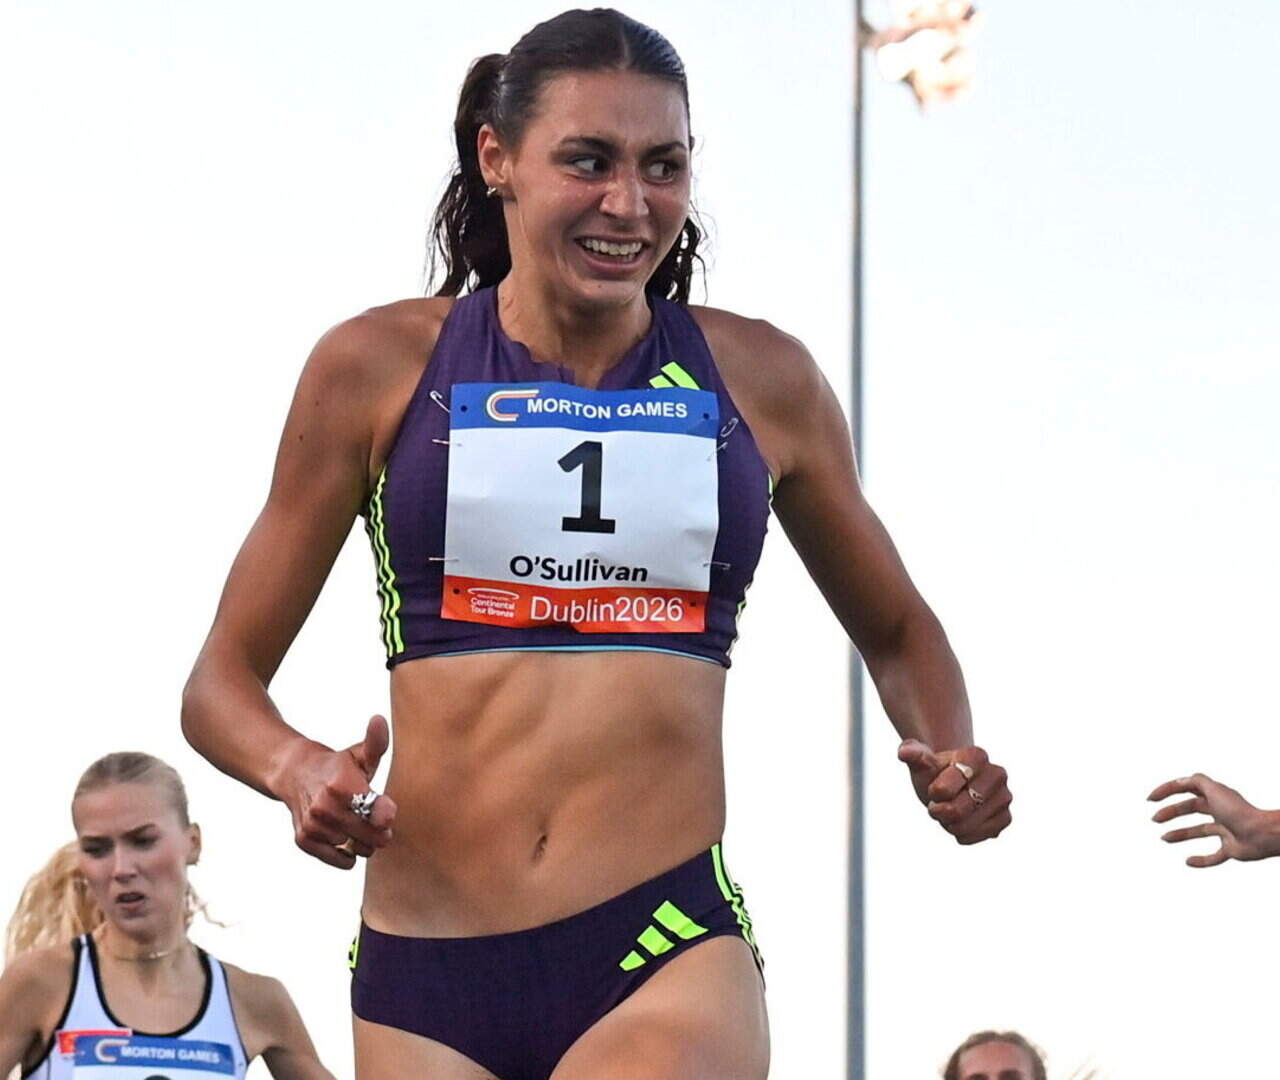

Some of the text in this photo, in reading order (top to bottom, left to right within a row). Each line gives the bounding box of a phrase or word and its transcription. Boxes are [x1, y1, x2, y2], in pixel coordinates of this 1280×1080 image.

[527, 398, 688, 419] MORTON GAMES
[557, 440, 616, 534] 1
[510, 555, 649, 583] O'Sullivan
[530, 596, 683, 624] Dublin2026
[120, 1045, 220, 1065] MORTON GAMES
